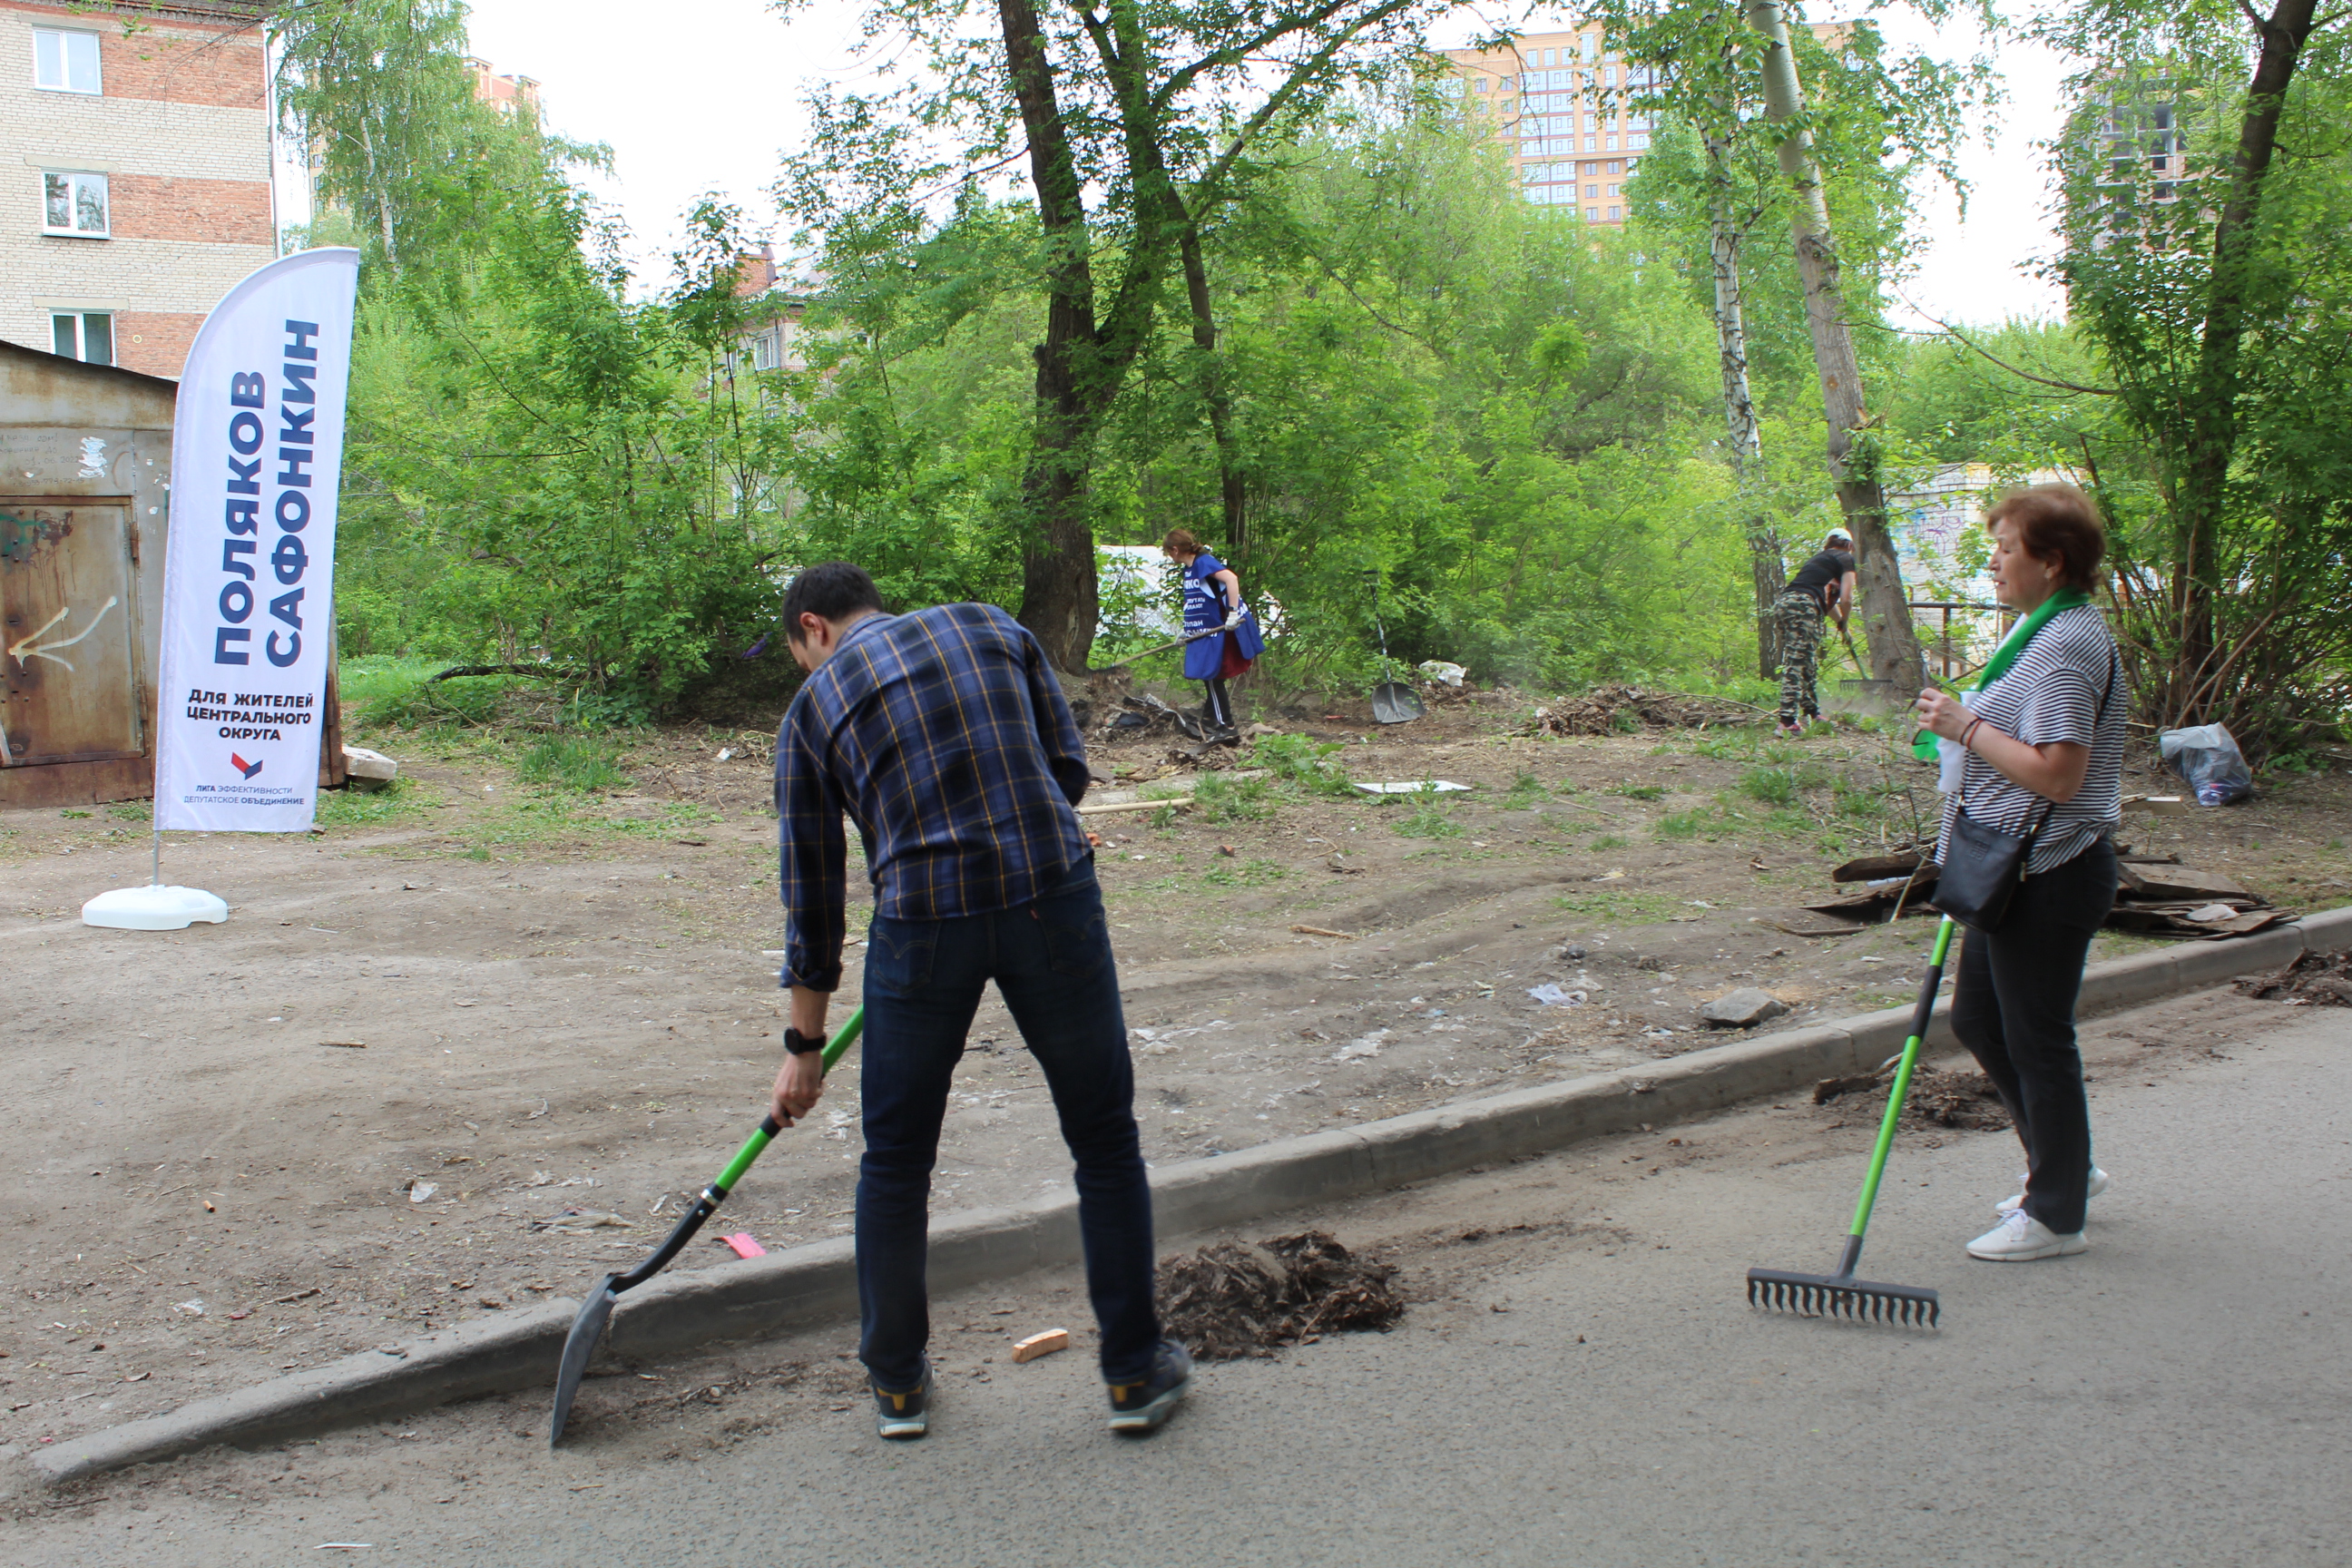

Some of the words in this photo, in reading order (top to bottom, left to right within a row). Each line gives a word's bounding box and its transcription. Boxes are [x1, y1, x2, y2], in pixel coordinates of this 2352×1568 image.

[266, 318, 320, 668] САФОНКИН
[214, 371, 266, 666] ПОЛЯКОВ
[188, 689, 227, 705] ДЛЯ
[233, 692, 314, 709] ЖИТЕЛЕЙ
[187, 706, 312, 725] ЦЕНТРАЛЬНОГО
[219, 726, 282, 741] ОКРУГА
[218, 785, 293, 795] ЭФФЕКТИВНОСТИ
[184, 795, 239, 804] ДЕПУТАТСКОЕ
[240, 797, 305, 806] ОБЪЕДИНЕНИЕ
